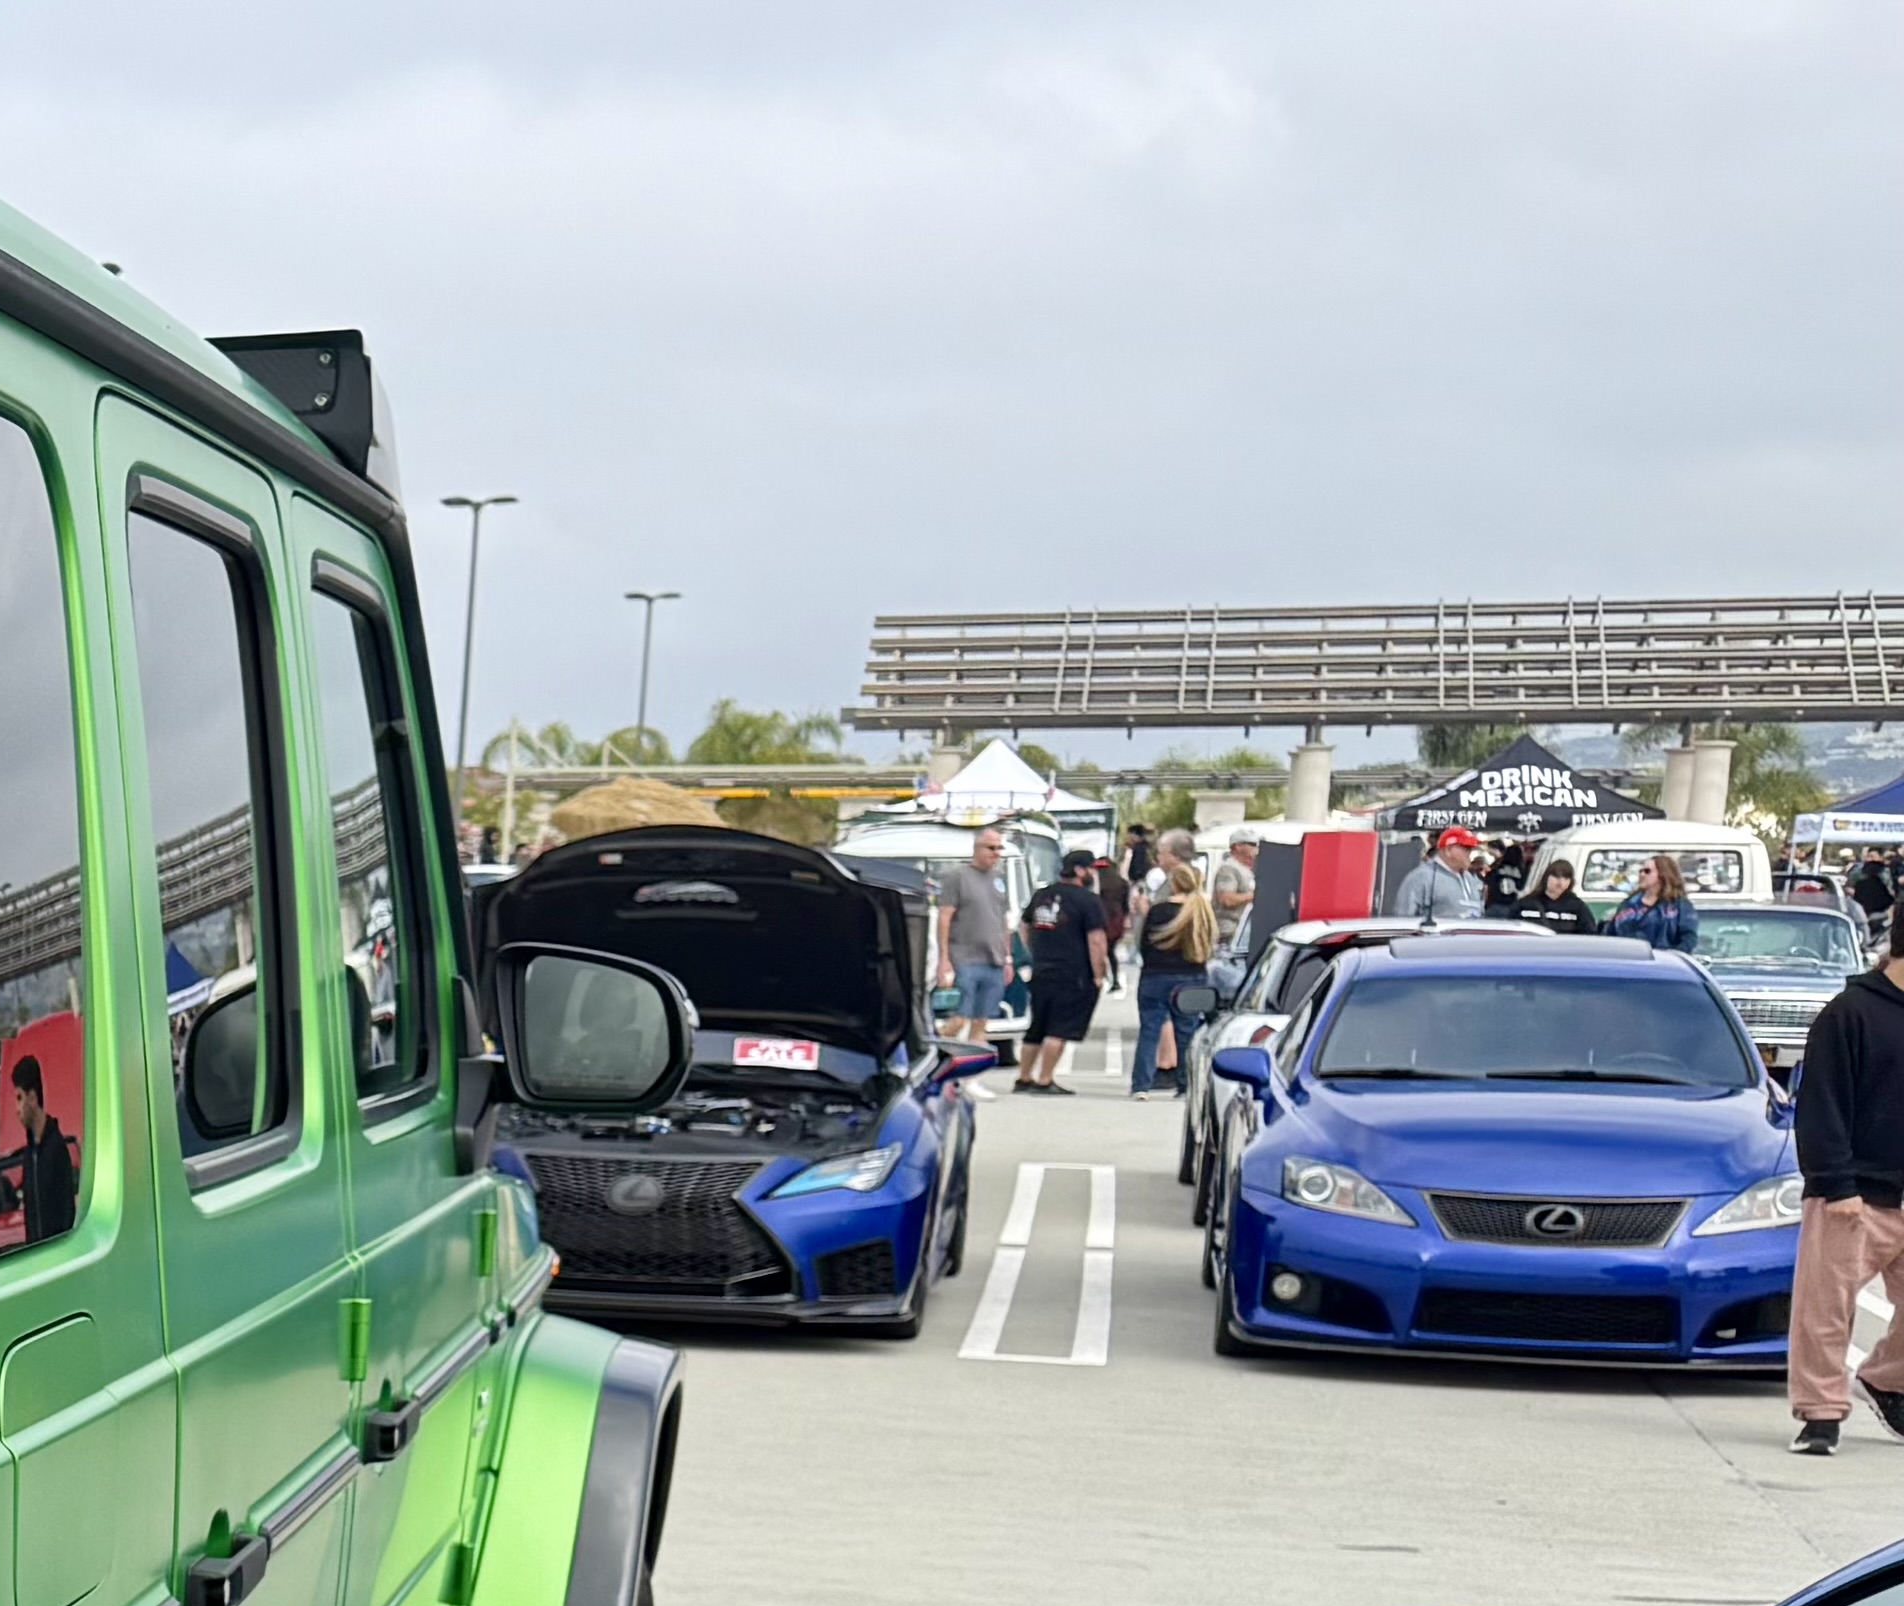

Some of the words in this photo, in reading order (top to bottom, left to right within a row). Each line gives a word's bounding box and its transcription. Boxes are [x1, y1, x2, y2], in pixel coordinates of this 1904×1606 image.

[1480, 764, 1574, 790] DRINK
[1459, 785, 1598, 808] MEXICAN
[747, 1047, 808, 1064] SALE
